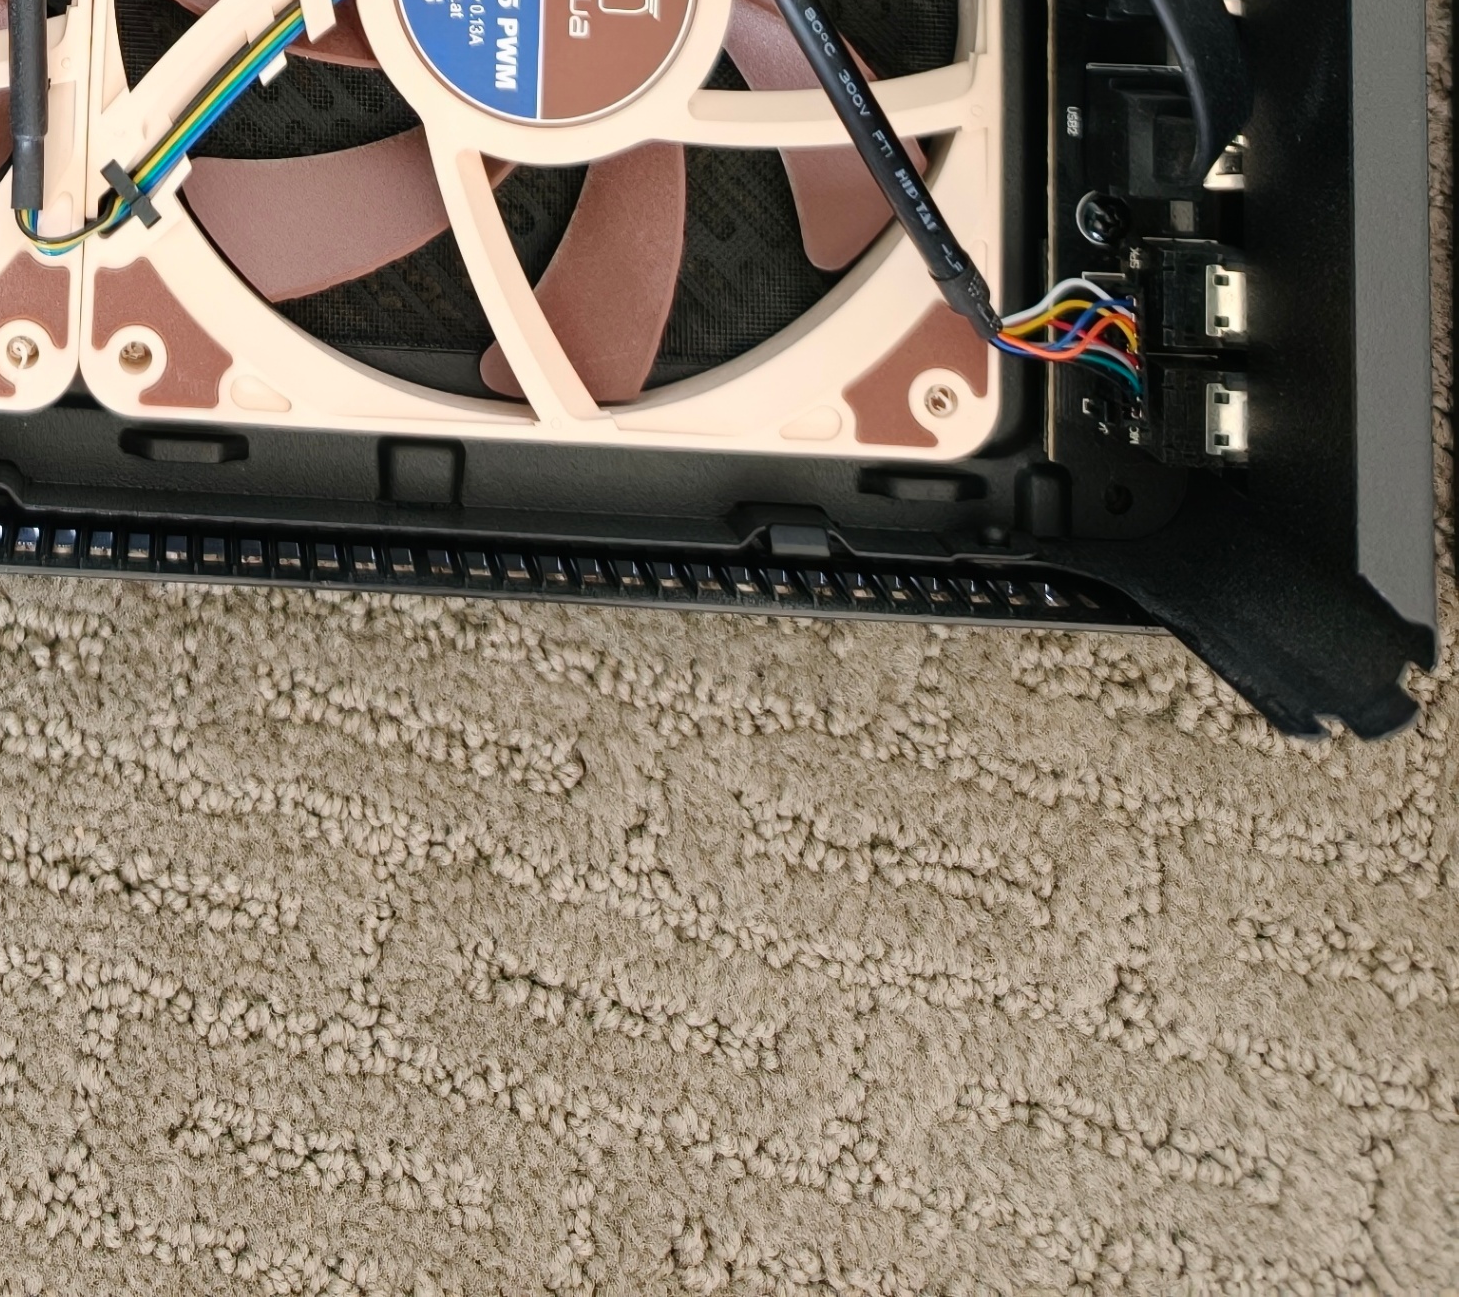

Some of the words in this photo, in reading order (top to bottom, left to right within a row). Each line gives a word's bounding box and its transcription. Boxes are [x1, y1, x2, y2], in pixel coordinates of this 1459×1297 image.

[469, 4, 484, 45] 0.13A
[495, 18, 518, 89] PWM
[838, 69, 870, 117] 300V
[1066, 106, 1082, 138] USB2
[1128, 246, 1140, 270] SPK
[1128, 426, 1140, 445] MIC
